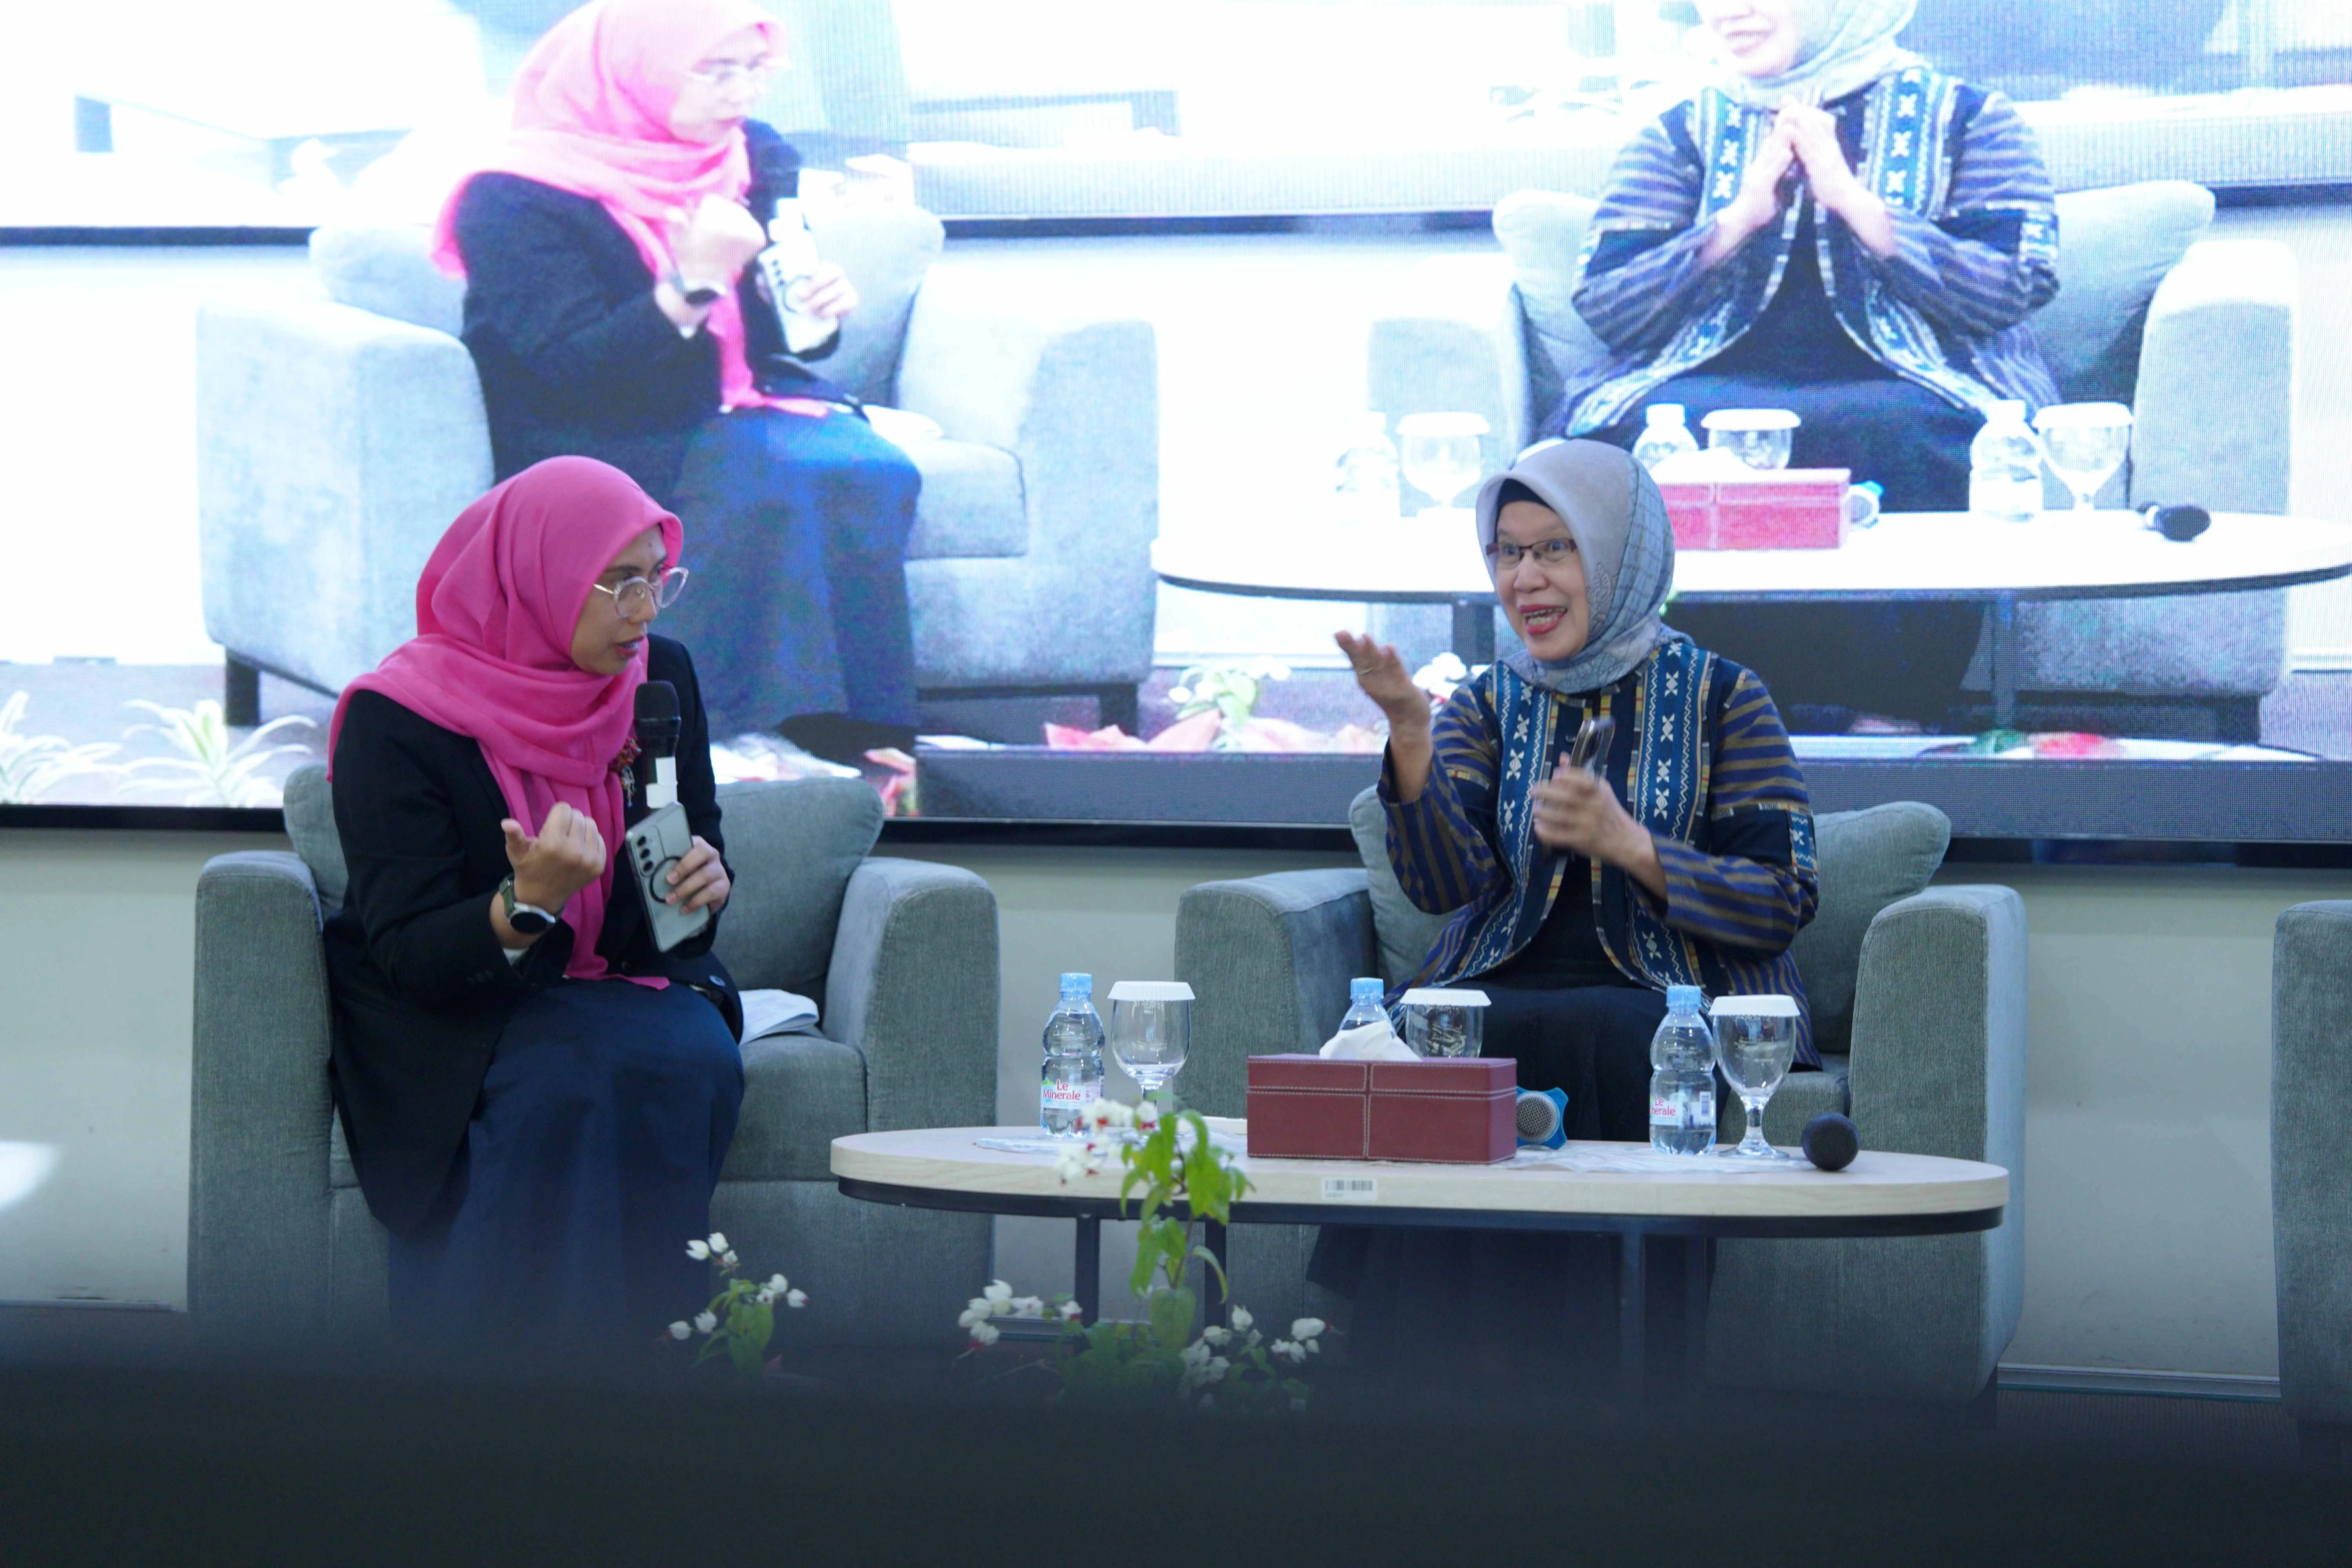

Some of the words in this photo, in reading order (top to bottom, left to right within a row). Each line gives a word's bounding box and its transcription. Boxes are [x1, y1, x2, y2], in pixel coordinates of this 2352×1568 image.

[1057, 1080, 1069, 1091] Le
[1043, 1089, 1081, 1100] Minerale
[1655, 1095, 1664, 1106] Le
